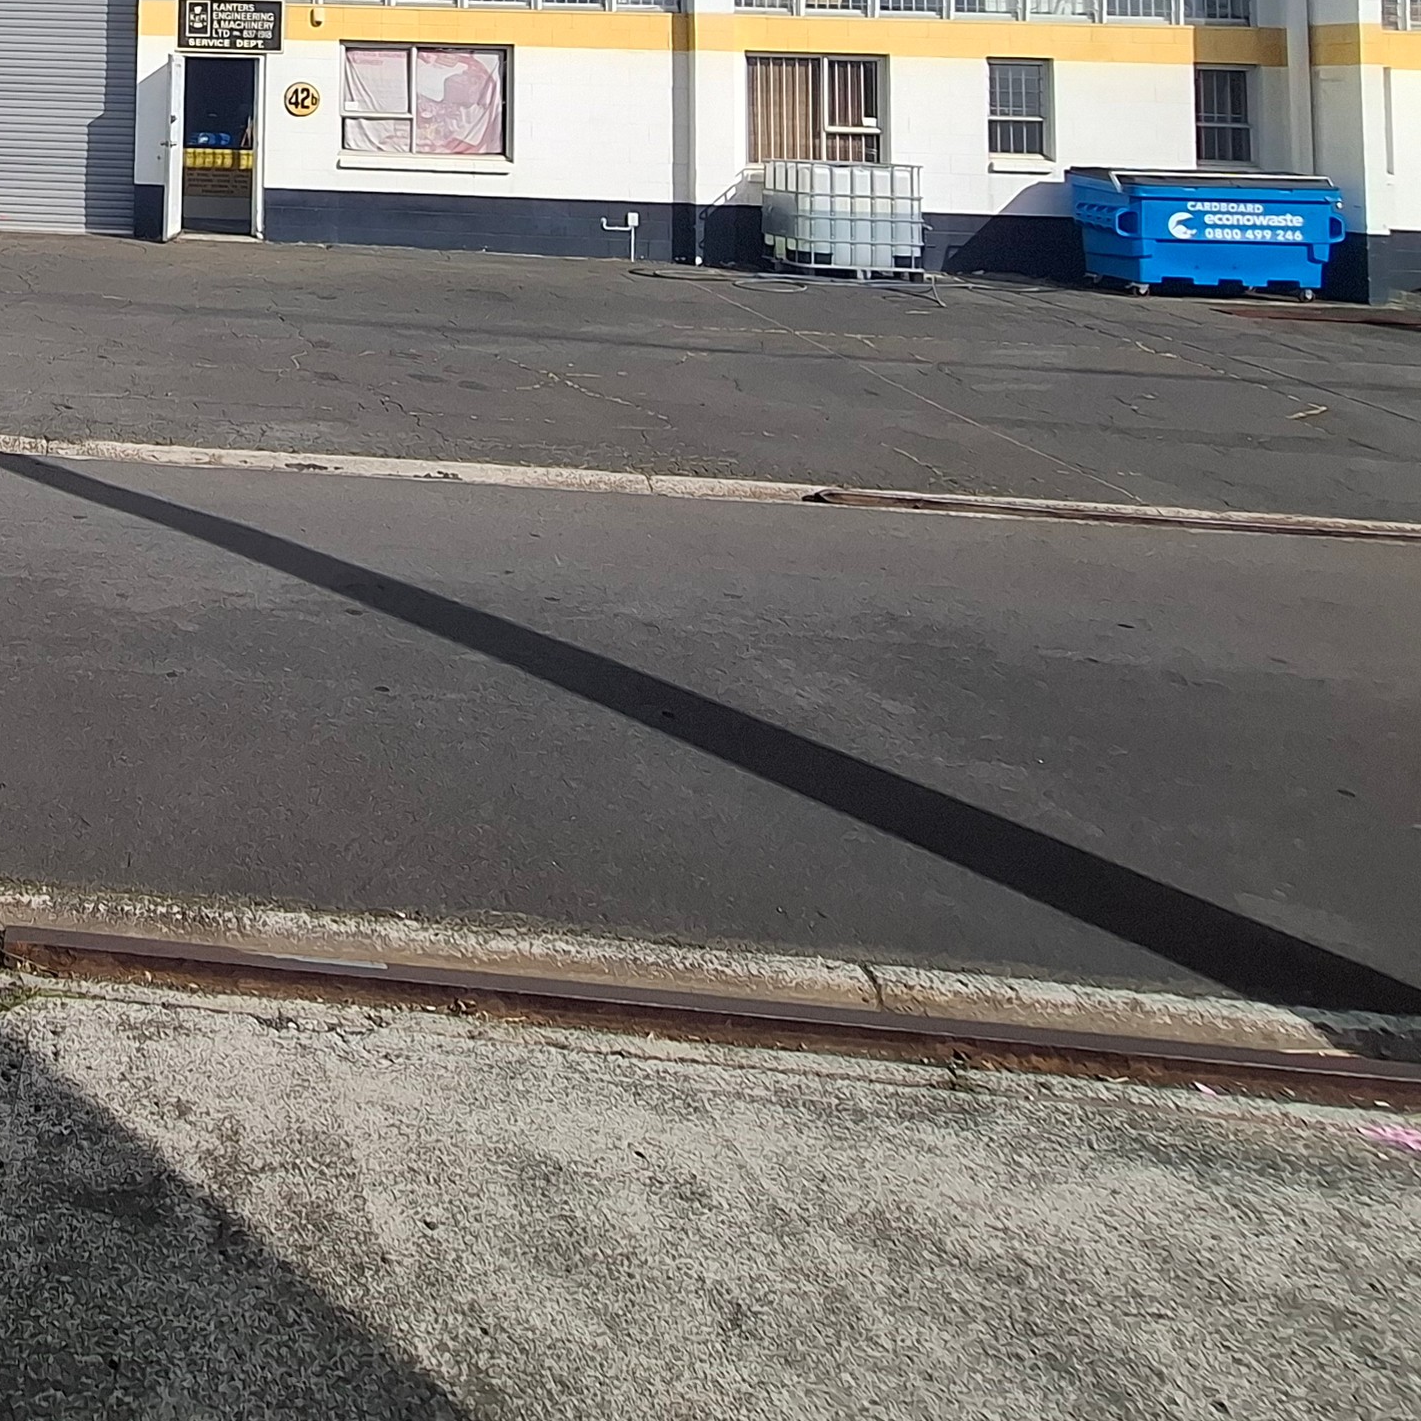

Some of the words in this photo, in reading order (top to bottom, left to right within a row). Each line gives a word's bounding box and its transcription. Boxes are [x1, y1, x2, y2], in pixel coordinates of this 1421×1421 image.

[212, 3, 255, 12] KANTERS
[212, 12, 275, 21] ENGINEERING
[221, 21, 275, 30] MACHINERY
[212, 29, 230, 38] LTD
[188, 38, 231, 47] SERVICE
[1186, 201, 1264, 213] CARDBOARD
[1203, 213, 1304, 227] econowaste
[1204, 227, 1242, 240] 0800
[1245, 229, 1272, 240] 499
[1275, 230, 1304, 241] 246
